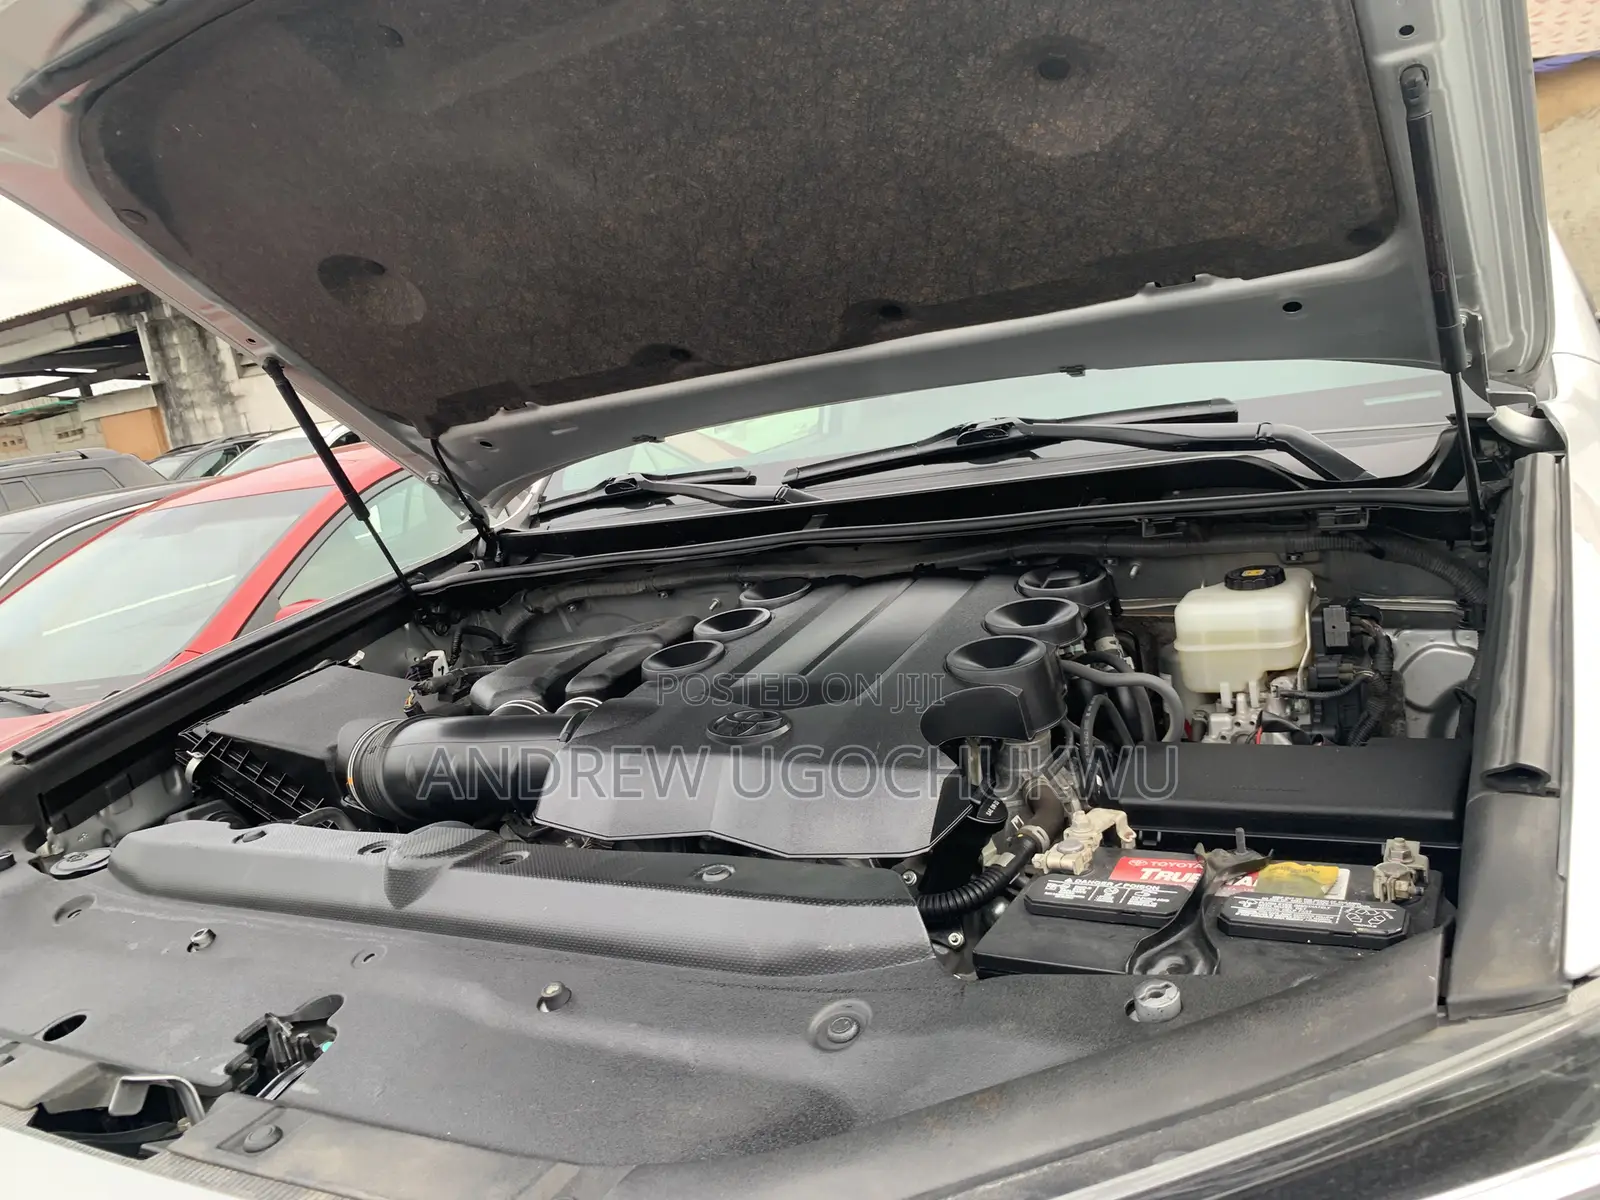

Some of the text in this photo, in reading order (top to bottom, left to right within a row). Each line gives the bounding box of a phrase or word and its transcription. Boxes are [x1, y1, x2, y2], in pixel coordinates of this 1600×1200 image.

[1150, 861, 1204, 870] TOYOTA
[1075, 879, 1114, 888] DANGER
[1123, 882, 1160, 892] POISON
